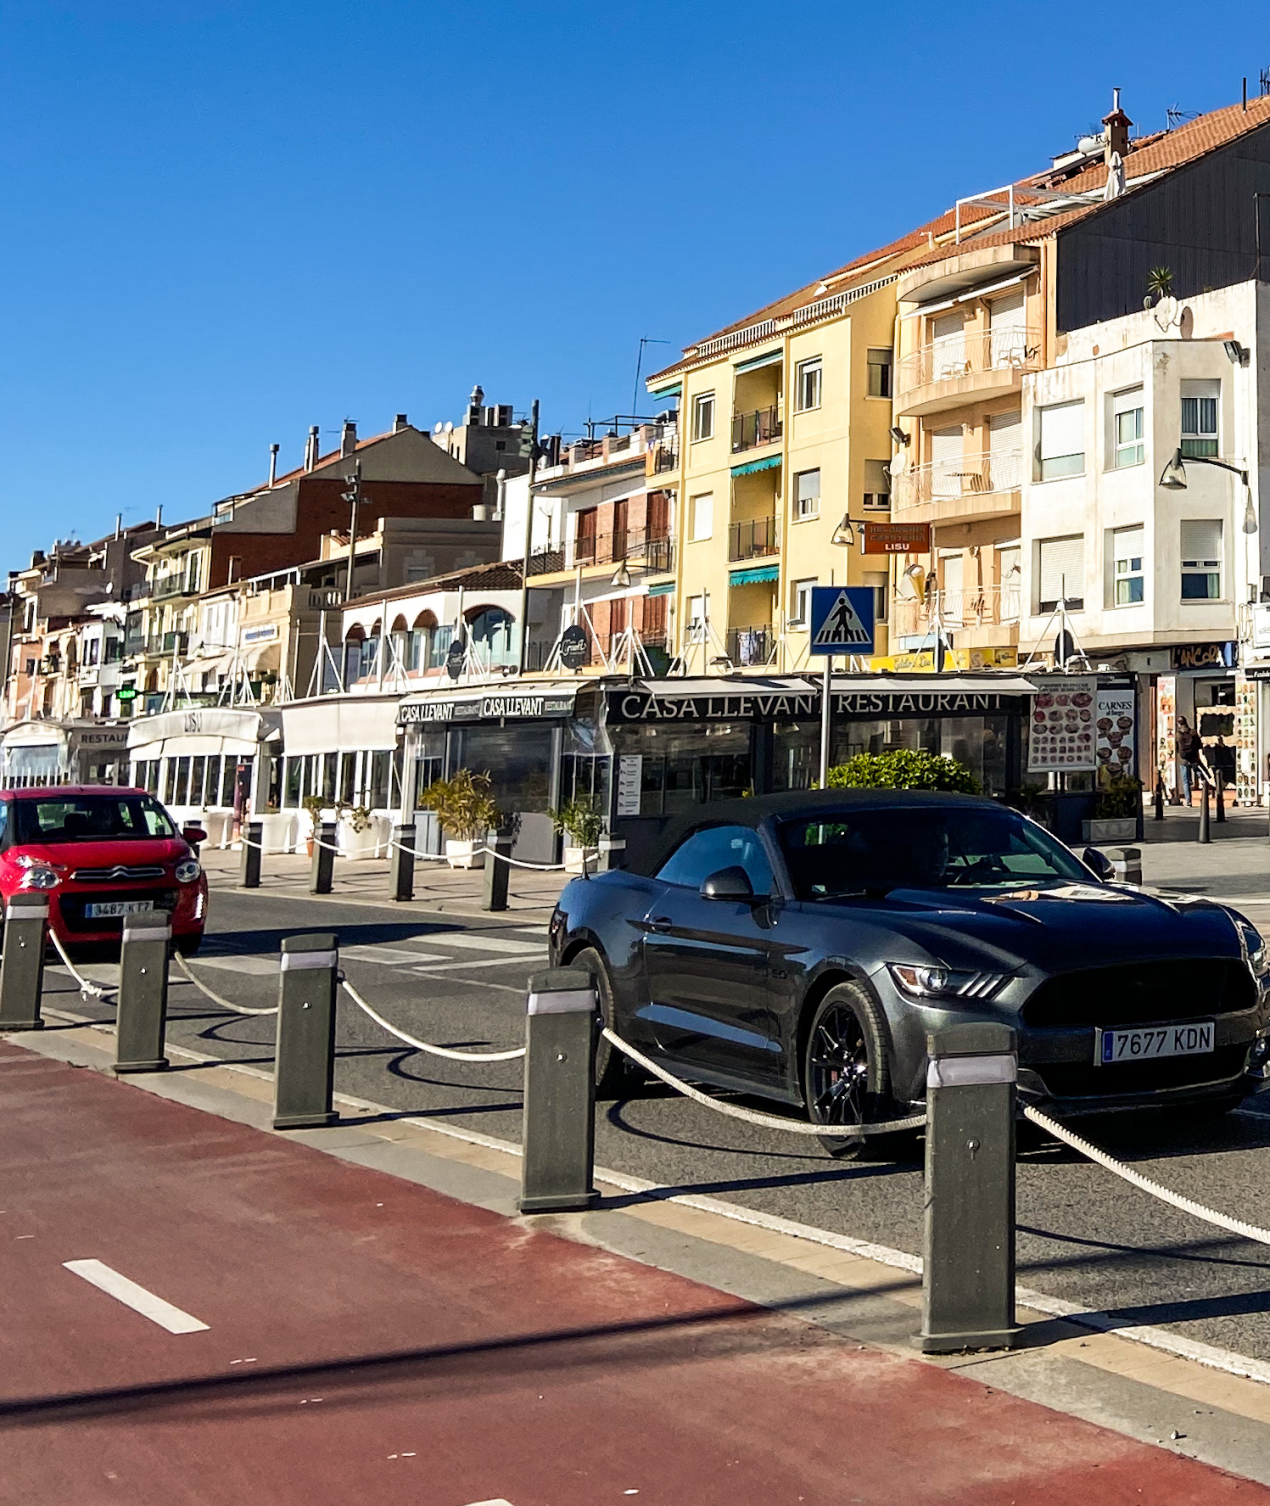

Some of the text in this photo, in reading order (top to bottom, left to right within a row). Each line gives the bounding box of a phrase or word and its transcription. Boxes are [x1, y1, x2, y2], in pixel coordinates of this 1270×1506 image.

[885, 543, 910, 551] LISU
[401, 705, 420, 722] CASA
[420, 702, 455, 721] LLEVANT
[483, 698, 501, 716] CASA
[501, 697, 544, 715] LLEVANT
[621, 695, 699, 719] CASA
[836, 693, 1002, 713] RESTAURANT
[1098, 701, 1132, 710] CARNES
[1117, 1026, 1210, 1057] 7677 KDN
